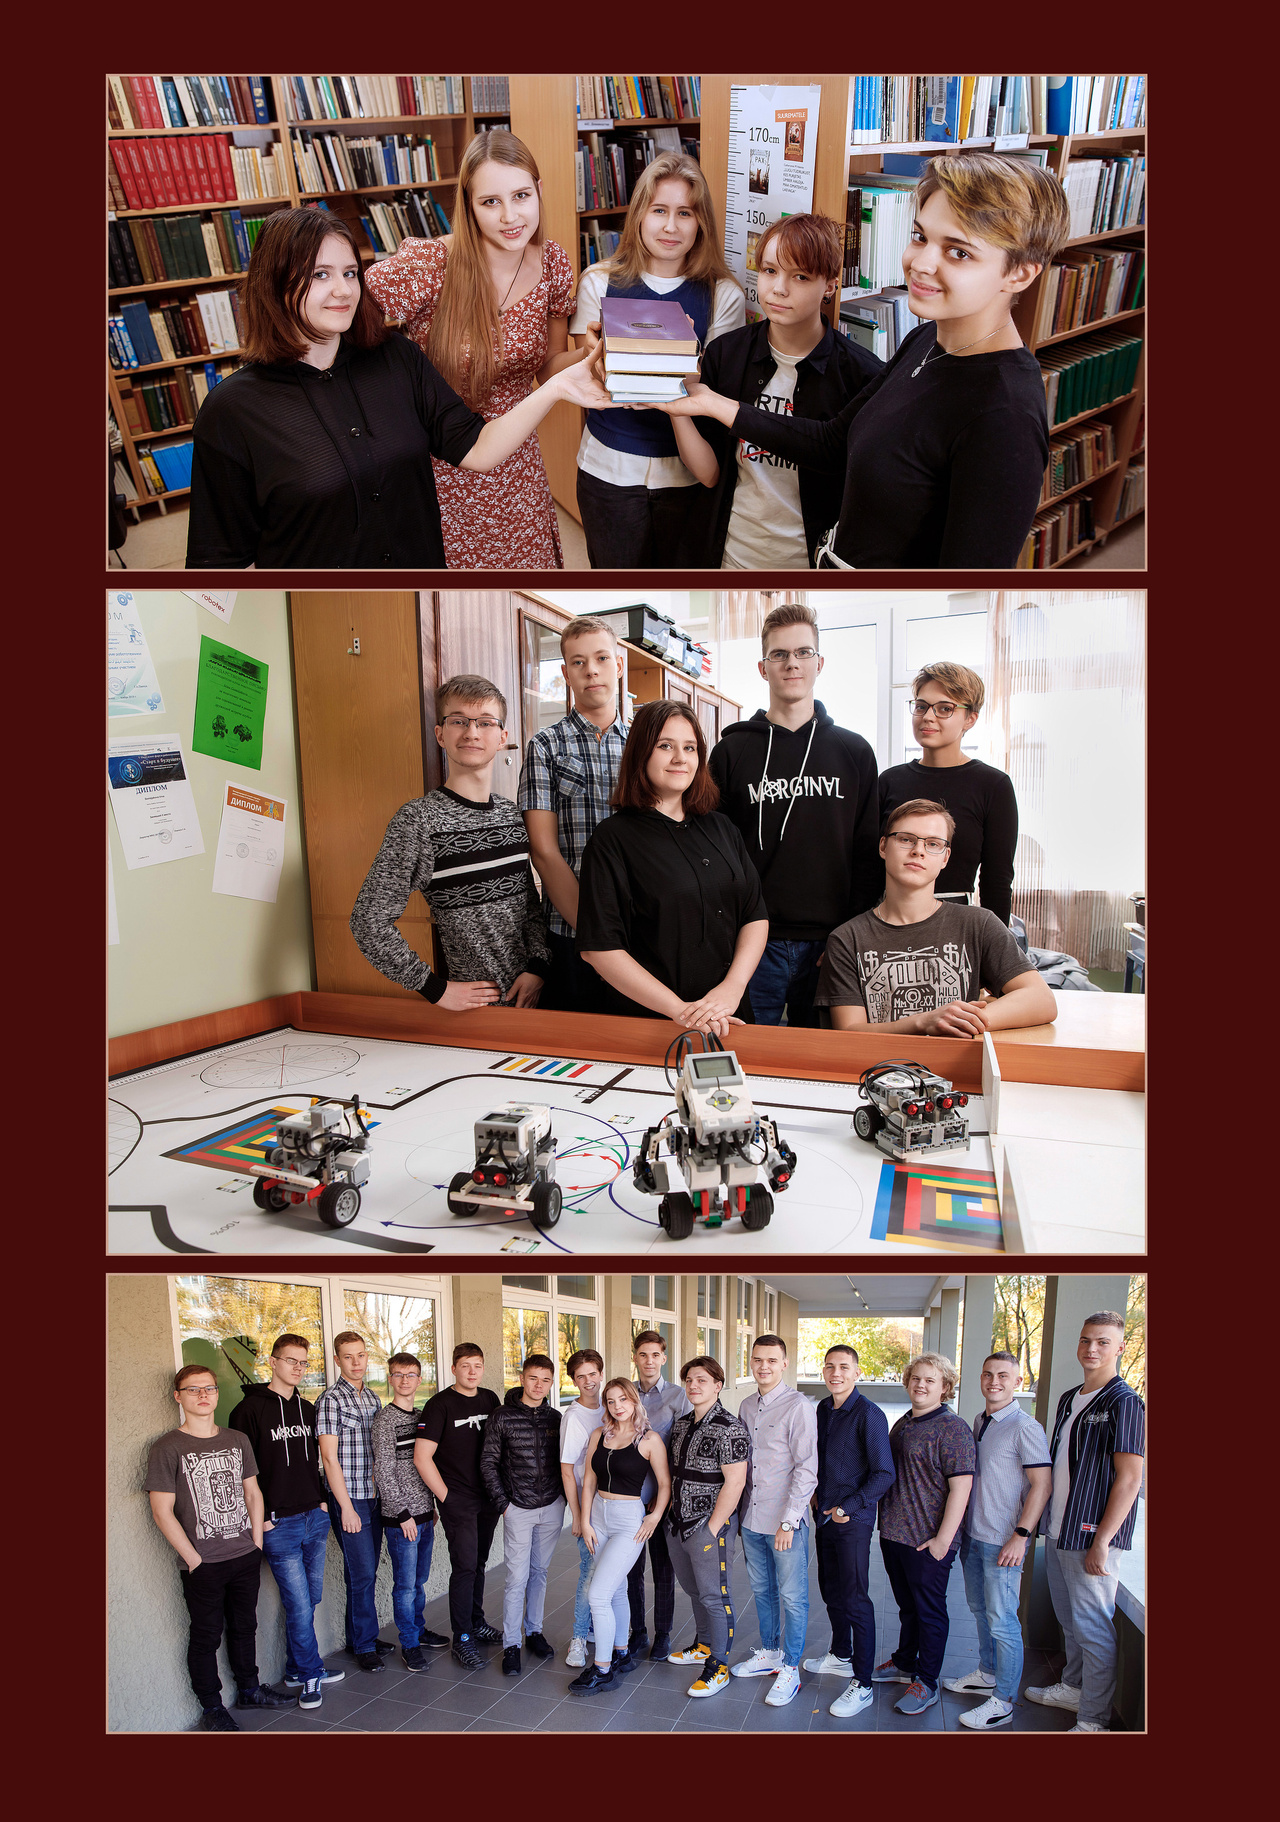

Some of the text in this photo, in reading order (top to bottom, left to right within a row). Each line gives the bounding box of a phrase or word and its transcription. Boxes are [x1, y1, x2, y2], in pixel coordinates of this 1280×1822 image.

[749, 127, 779, 144] 170cm
[202, 594, 225, 613] robotex
[136, 784, 168, 795] ДИПЛОМ
[231, 797, 262, 812] ДИПЛОМ
[889, 958, 941, 985] FOLLOW
[938, 987, 959, 996] WILD
